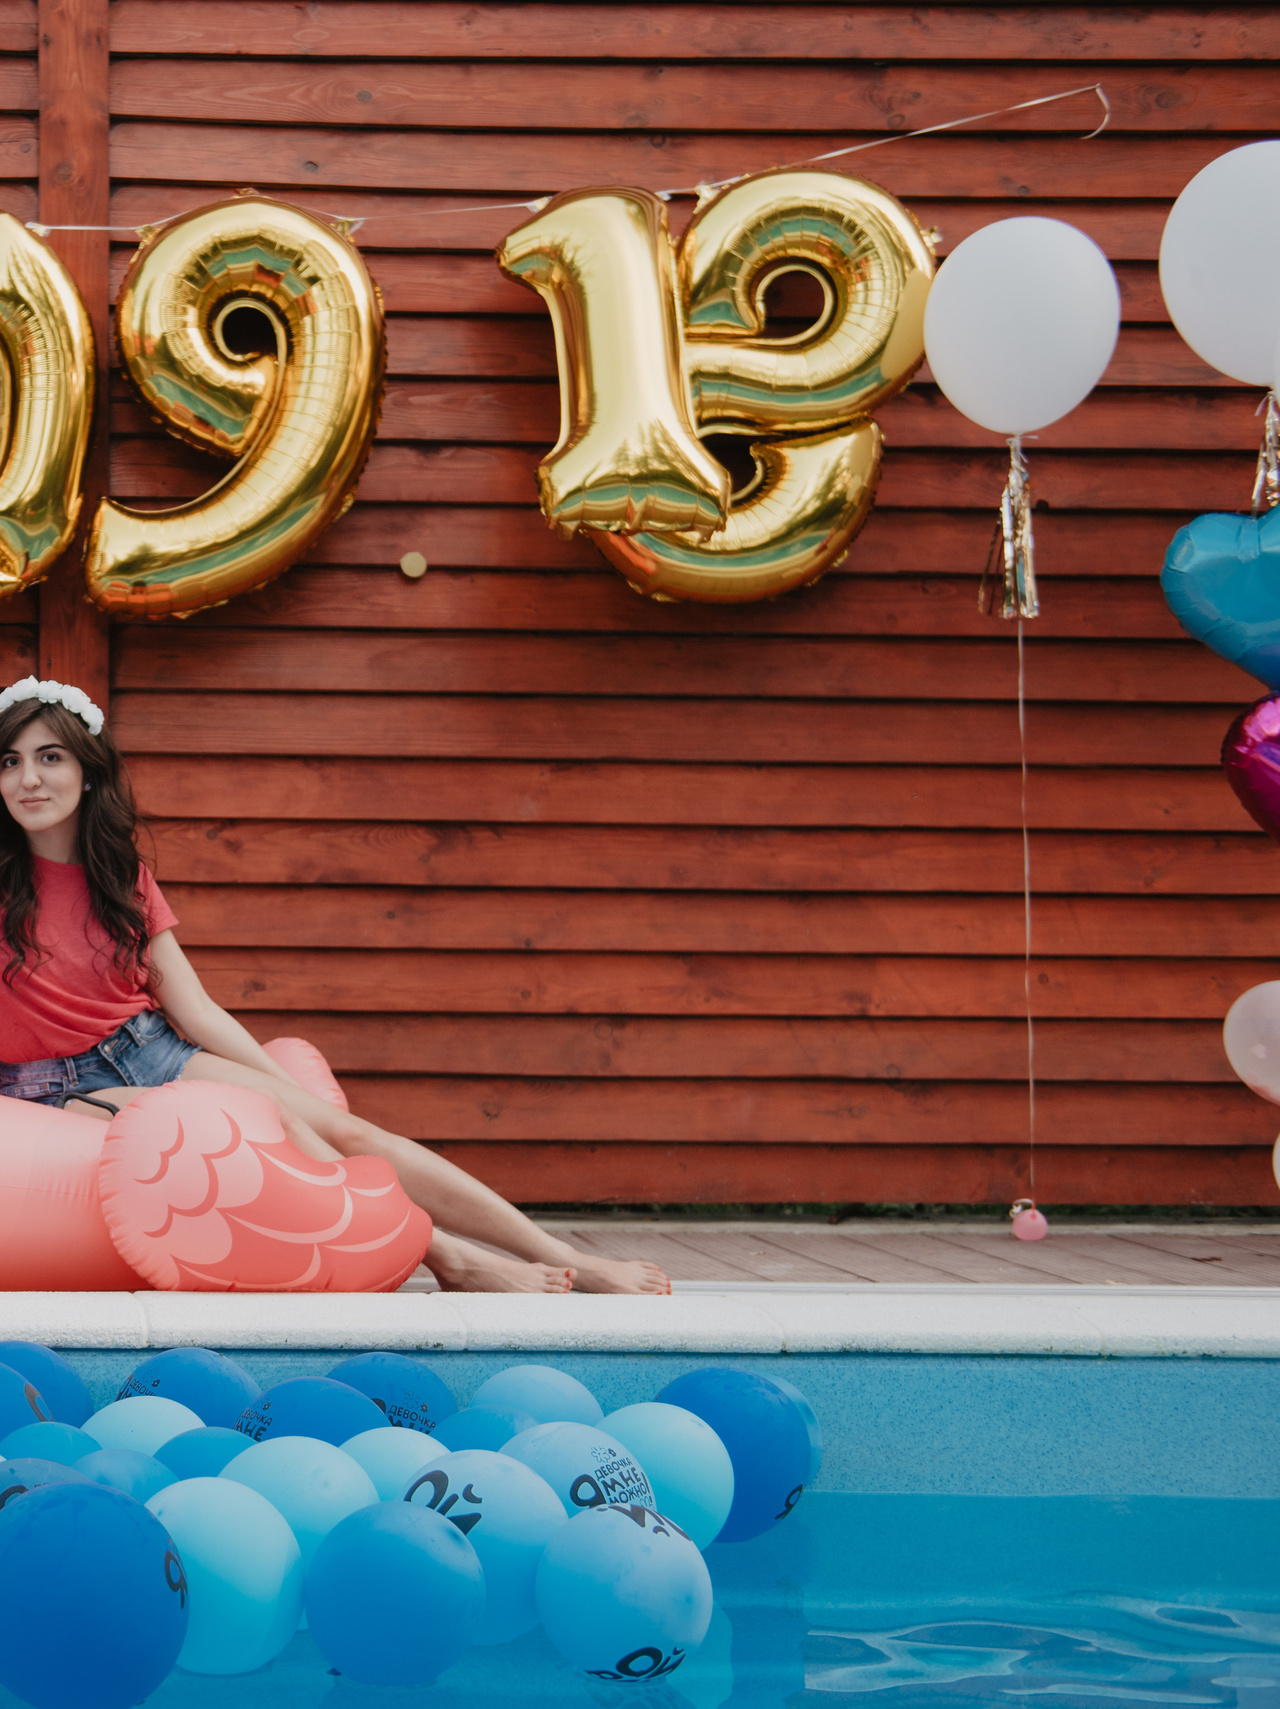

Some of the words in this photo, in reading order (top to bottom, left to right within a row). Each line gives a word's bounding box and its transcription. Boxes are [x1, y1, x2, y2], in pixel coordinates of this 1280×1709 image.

[388, 1405, 437, 1429] ДЕВОЧКА
[594, 1457, 633, 1481] ДЕВОЧКА
[601, 1467, 642, 1496] МНЕ
